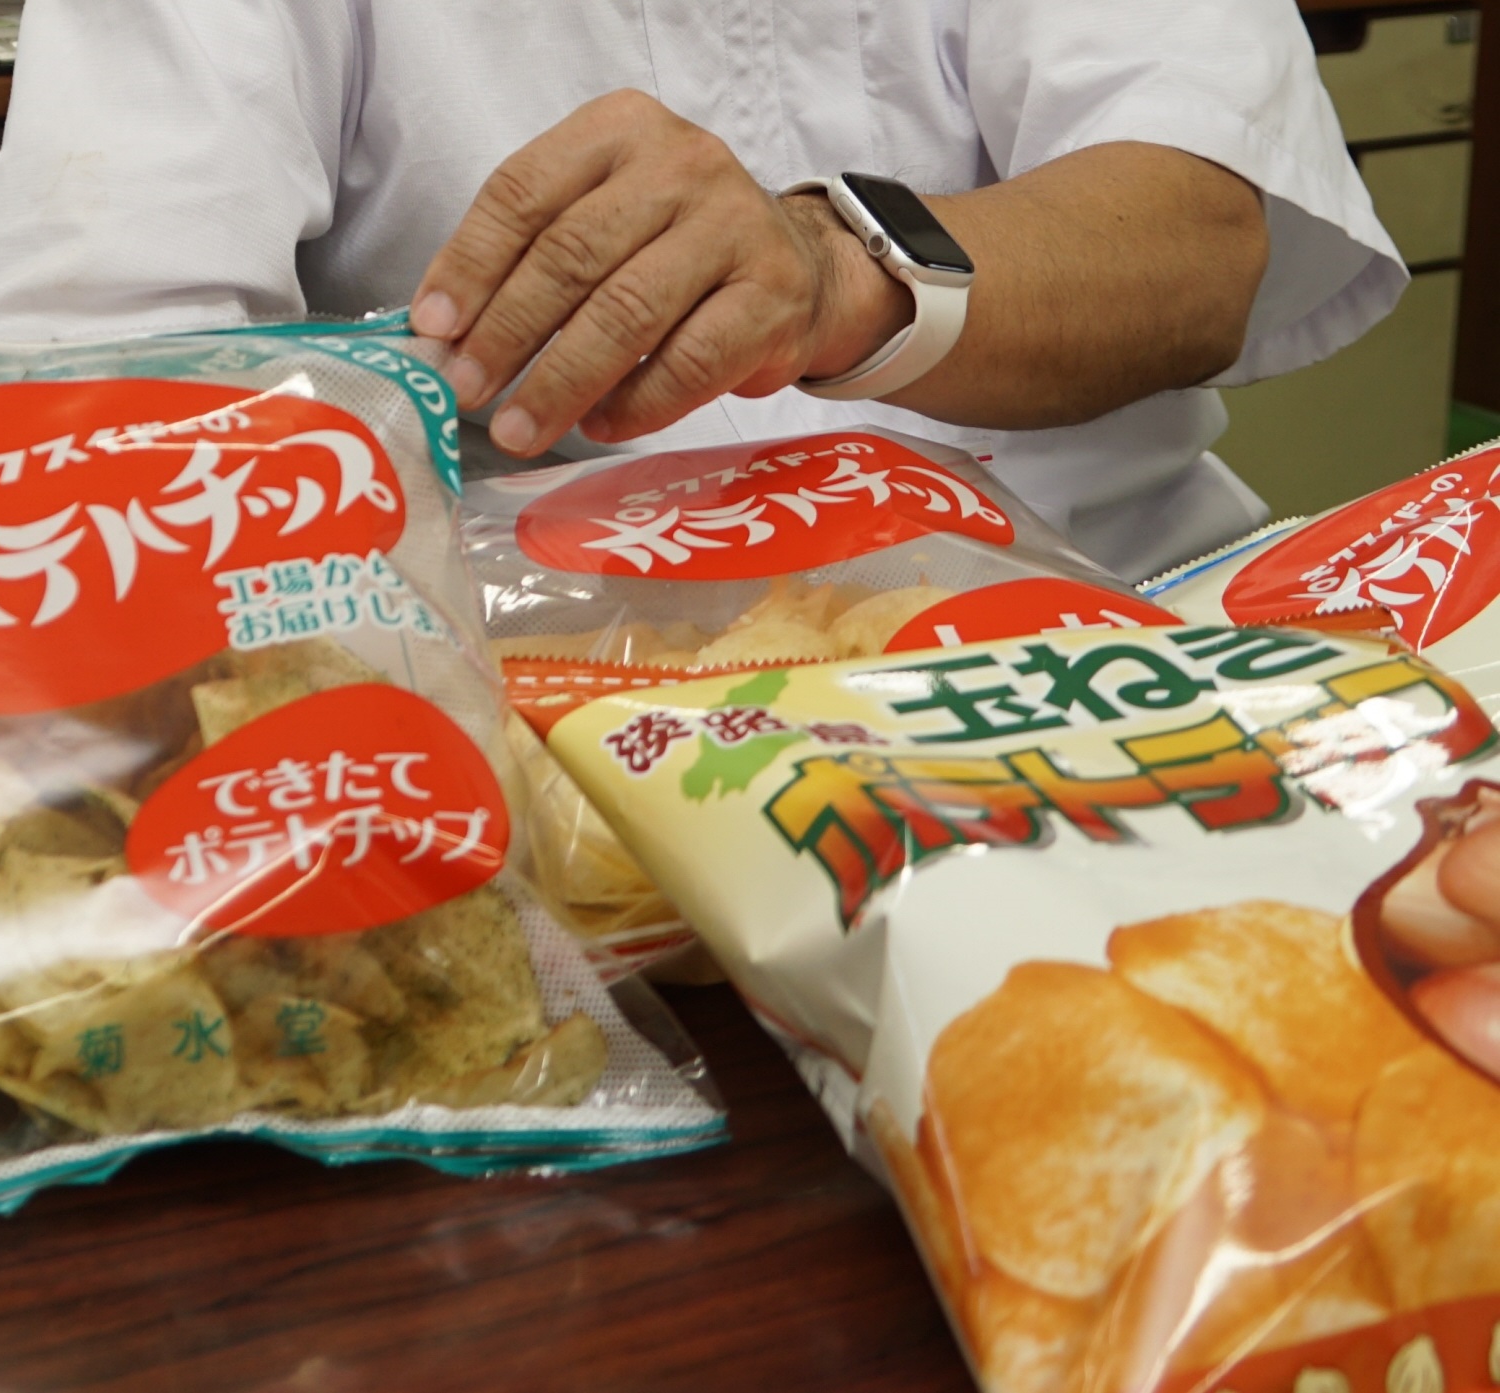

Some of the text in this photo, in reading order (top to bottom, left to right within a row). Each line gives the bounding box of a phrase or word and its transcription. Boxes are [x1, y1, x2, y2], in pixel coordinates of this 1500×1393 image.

[618, 441, 876, 507] キクスイドーの
[1300, 472, 1463, 582] キクスイドーの
[198, 751, 433, 813] できたて
[166, 806, 492, 887] ポテトチップ
[77, 1002, 328, 1080] 菊水堂
